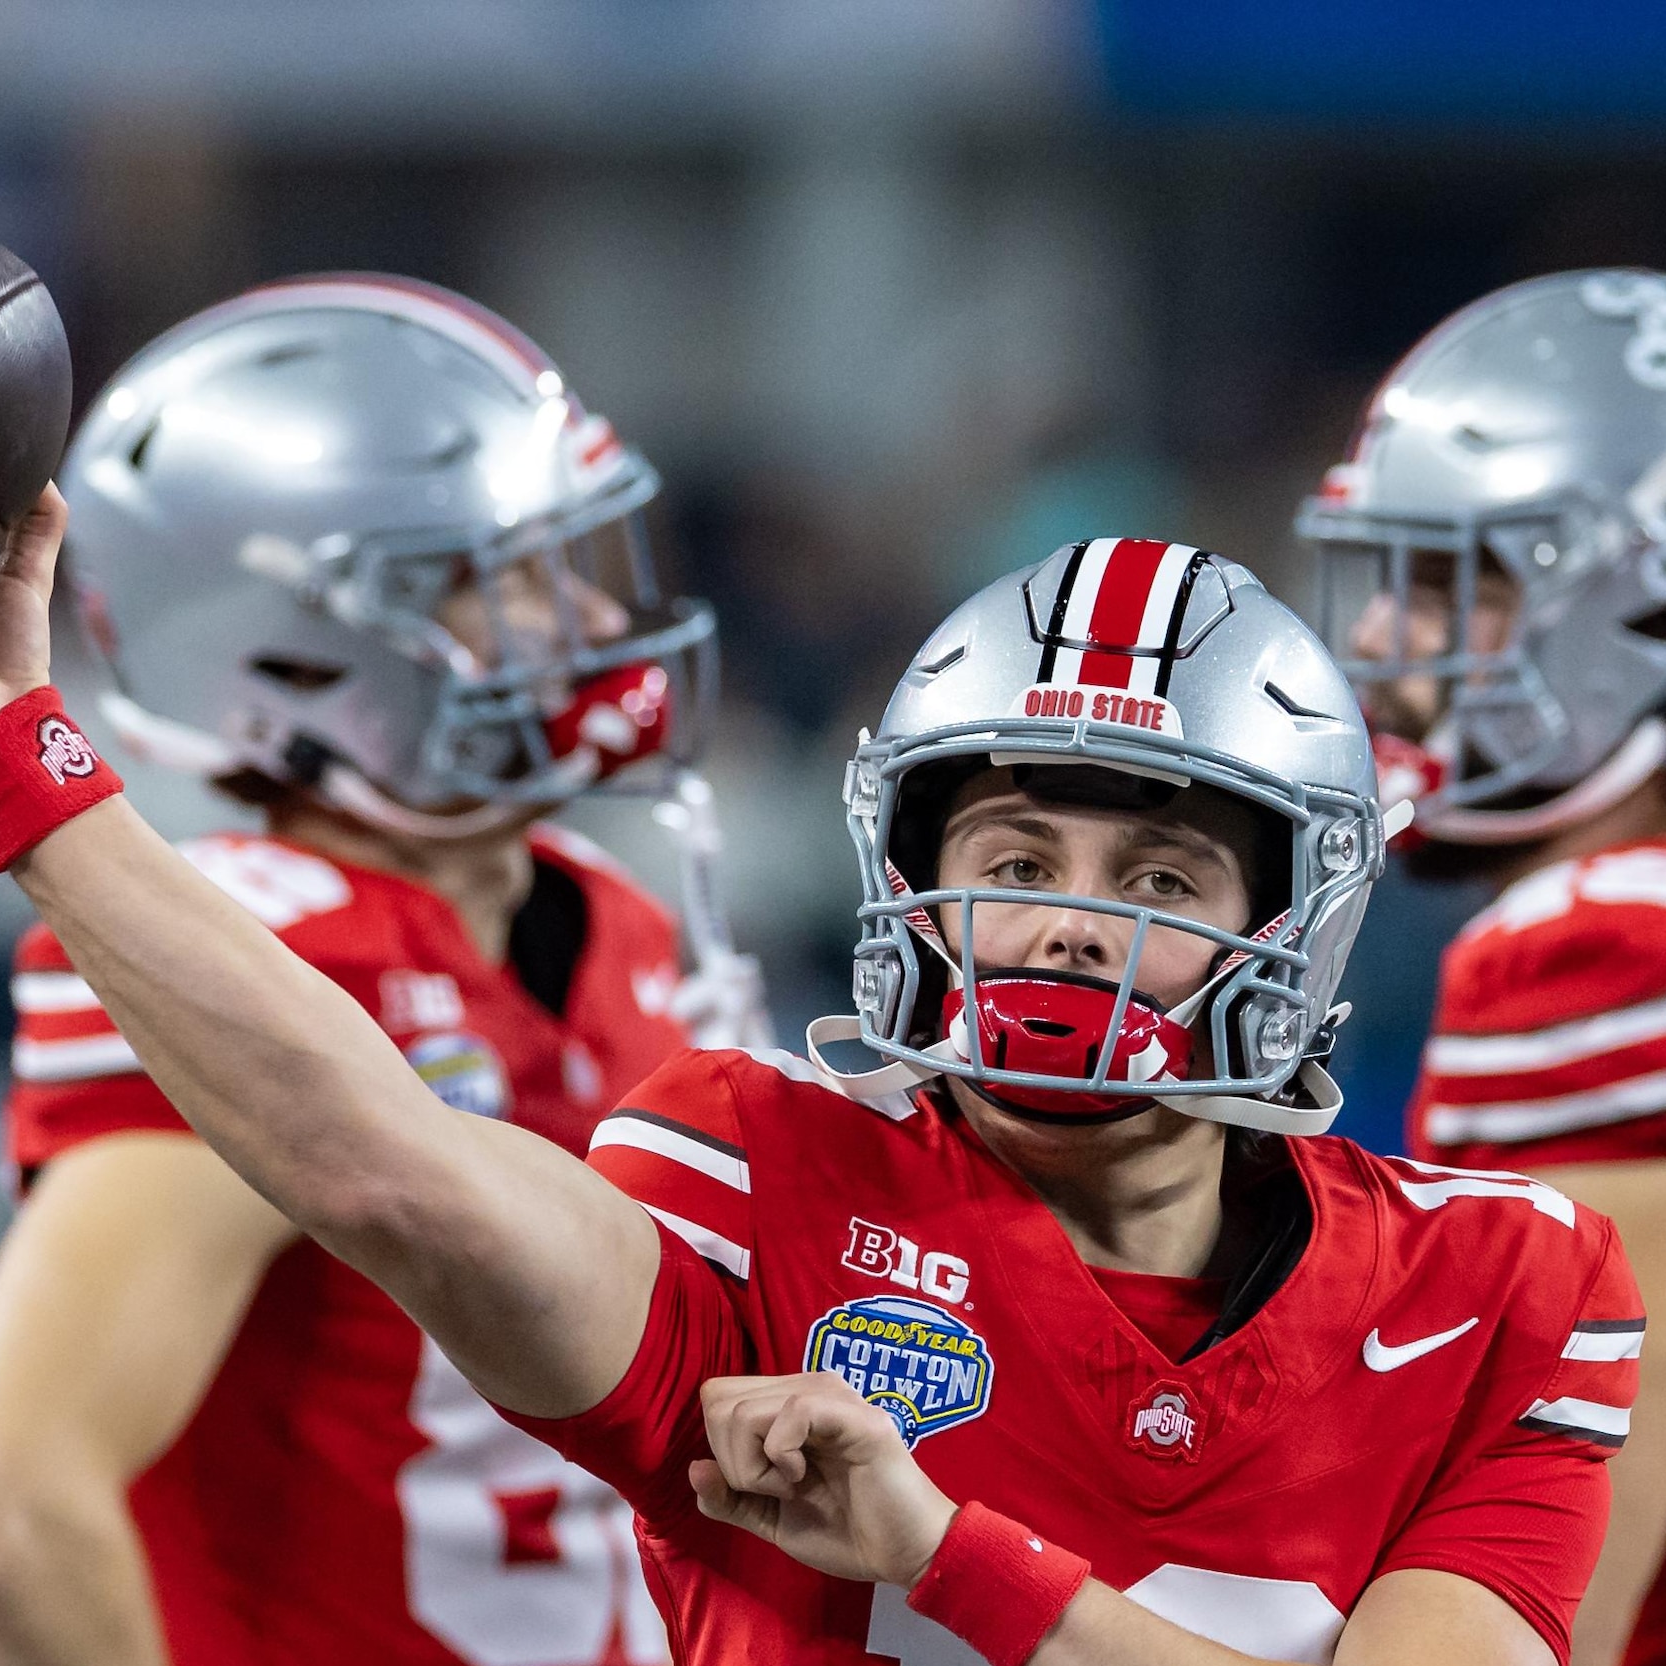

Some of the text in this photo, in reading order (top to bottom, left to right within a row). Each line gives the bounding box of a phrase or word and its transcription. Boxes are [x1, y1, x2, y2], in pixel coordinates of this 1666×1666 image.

[1025, 689, 1166, 731] OHIO STATE
[832, 1312, 978, 1358] GOODYEAR
[821, 1333, 978, 1406] COTTON
[848, 1367, 944, 1412] BOWL
[879, 1397, 916, 1429] ASSIC
[1134, 1405, 1196, 1449] OHIO STATE
